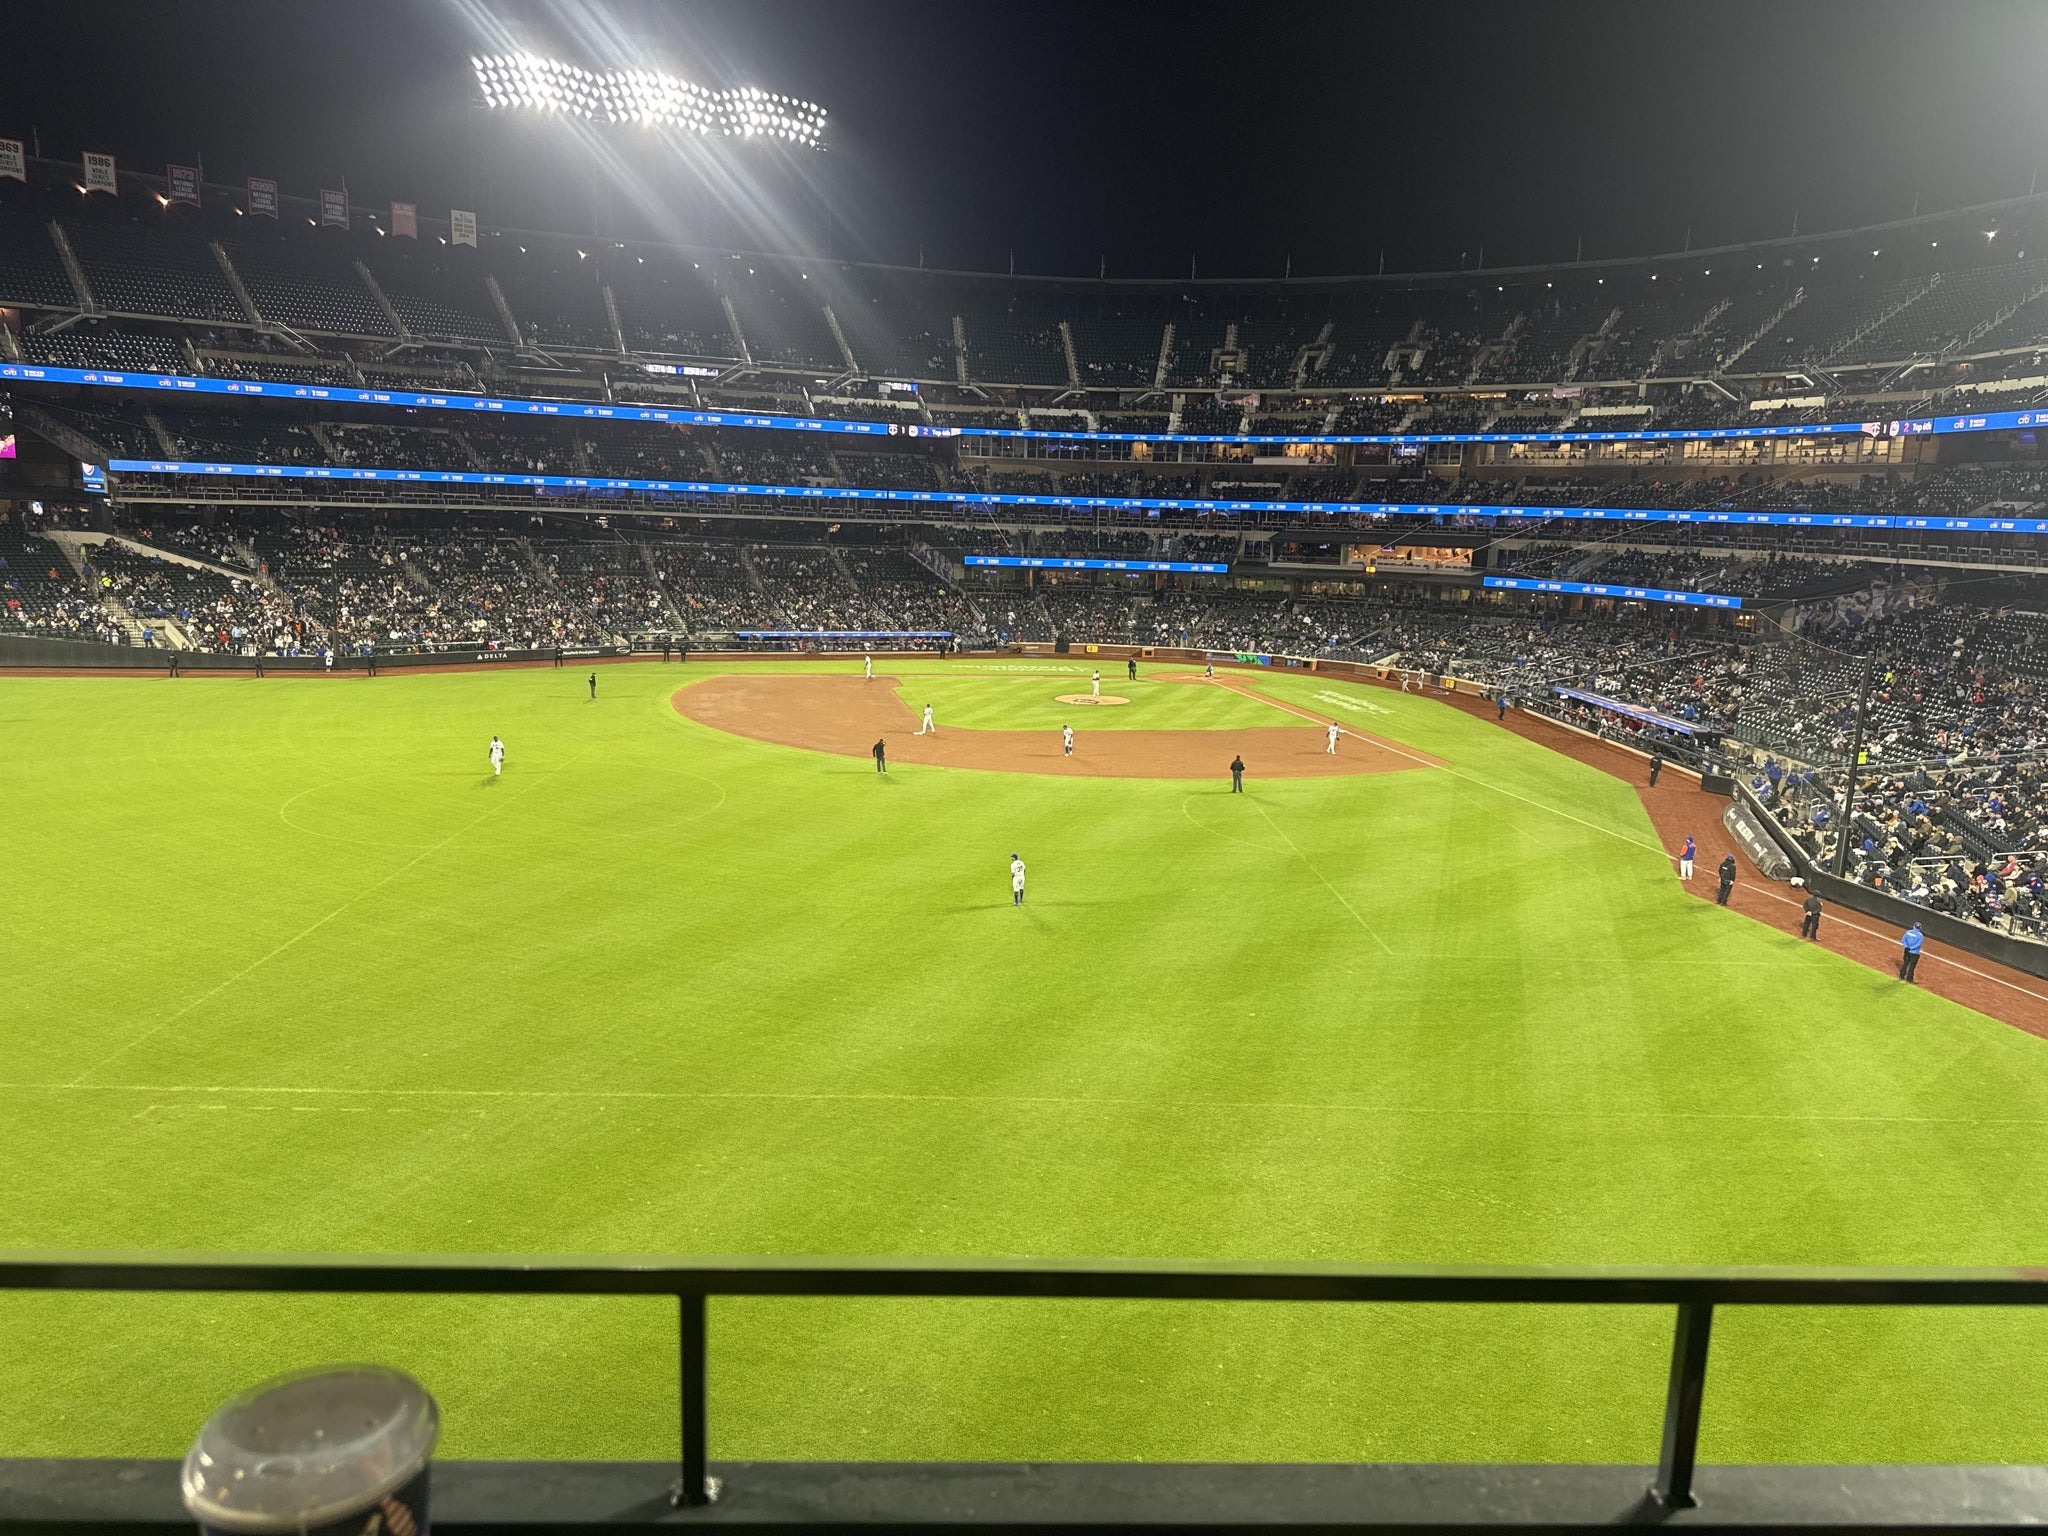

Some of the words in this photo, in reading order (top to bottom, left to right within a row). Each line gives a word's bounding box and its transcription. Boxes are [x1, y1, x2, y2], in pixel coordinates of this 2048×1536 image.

[88, 155, 110, 167] 1986
[88, 178, 114, 187] CHAMPIONS
[3, 367, 17, 376] citi
[84, 373, 97, 381] citi
[1912, 423, 1922, 433] Top
